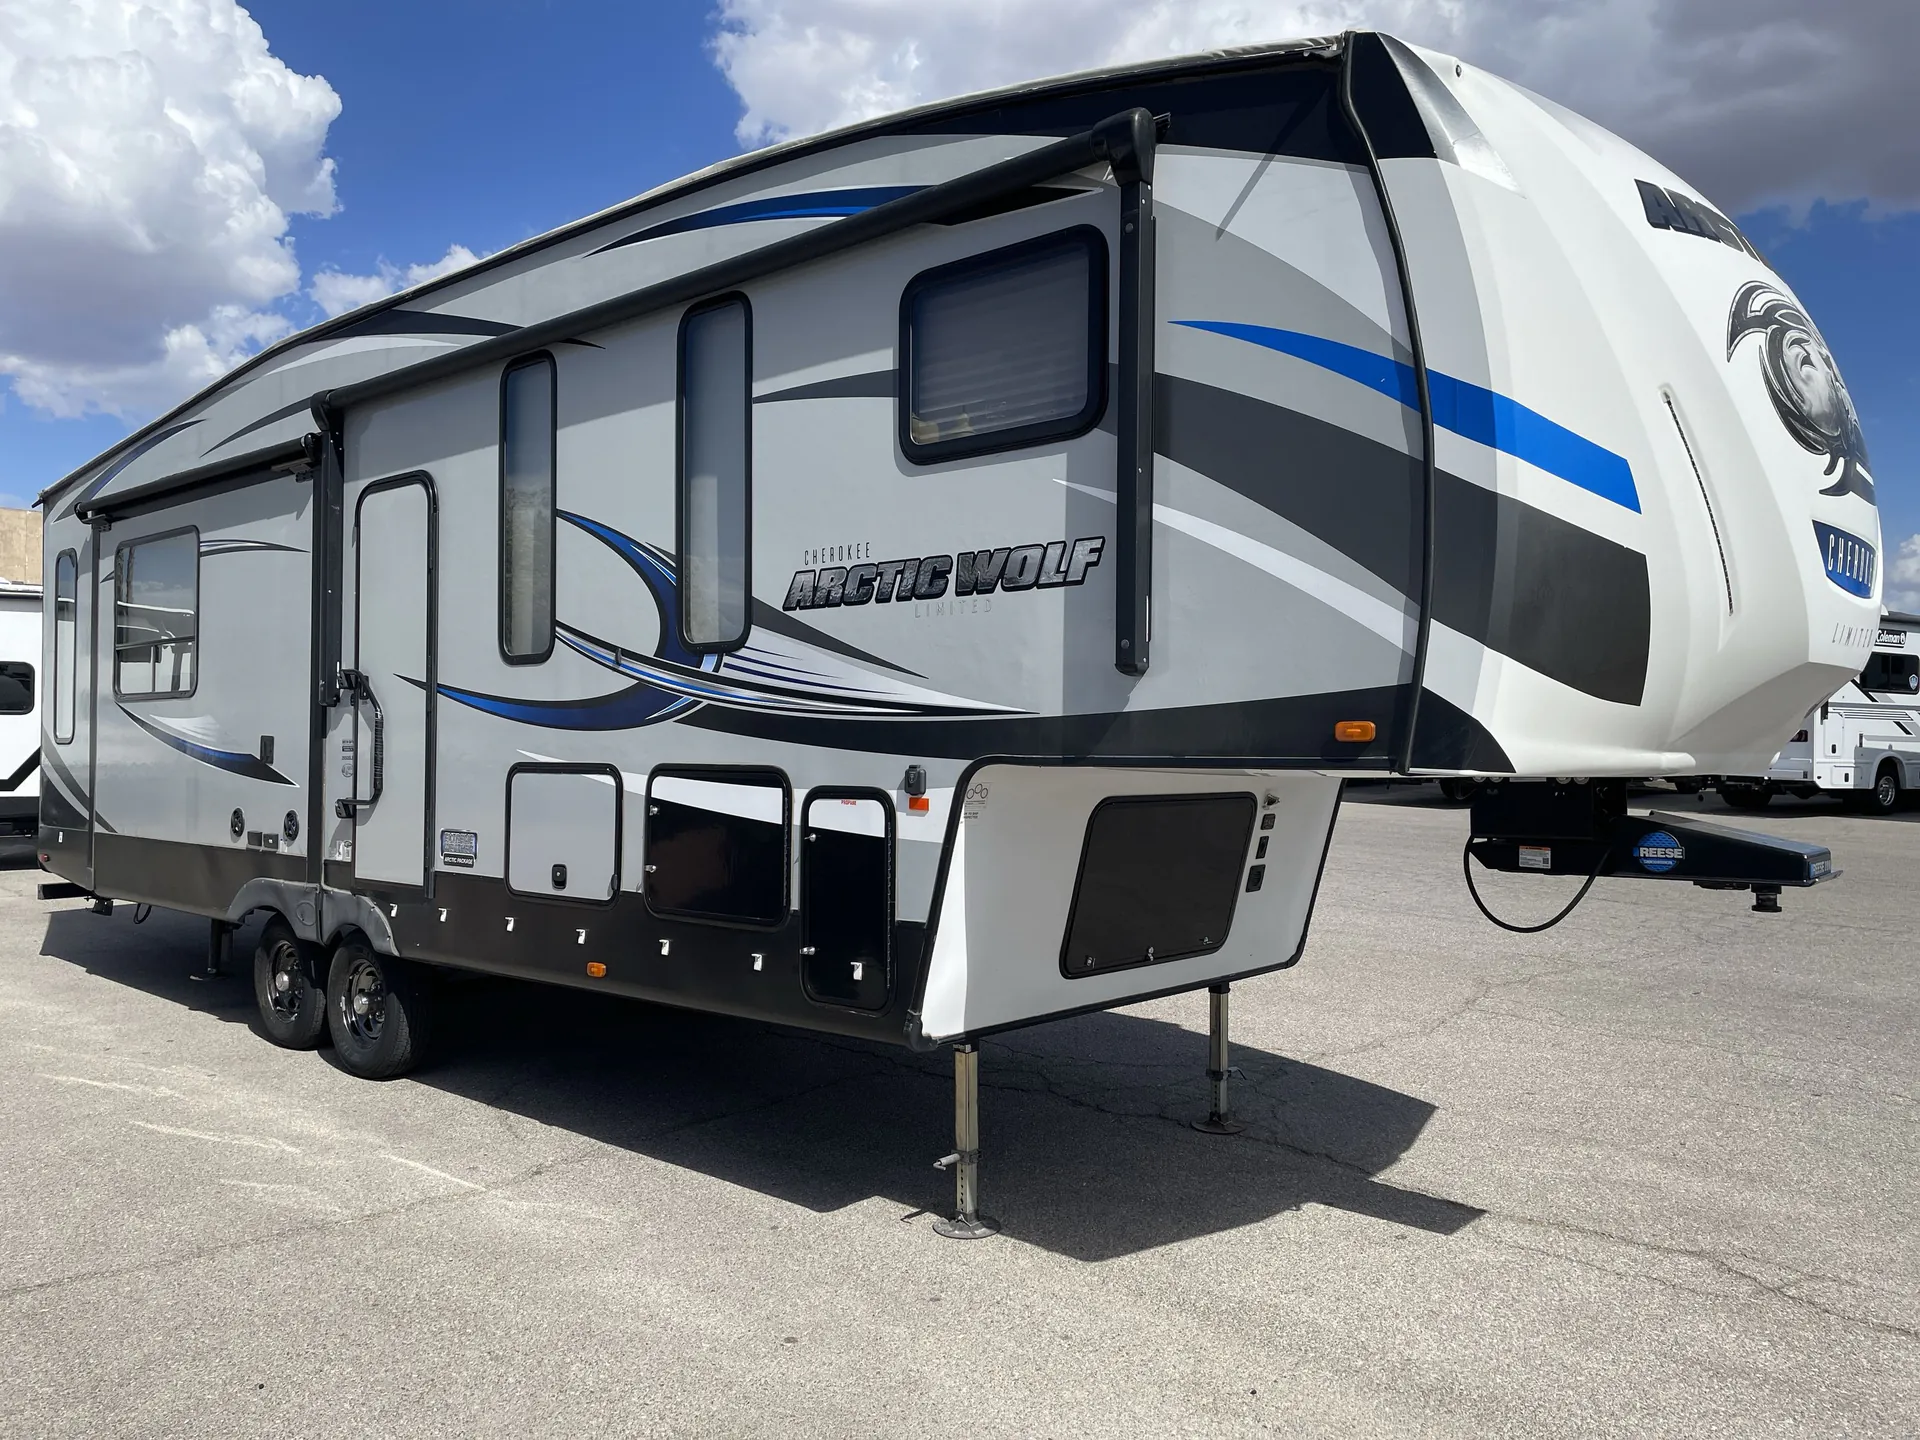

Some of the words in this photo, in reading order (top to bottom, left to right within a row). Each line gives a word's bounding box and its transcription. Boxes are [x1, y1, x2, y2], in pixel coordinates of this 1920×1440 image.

[804, 541, 871, 566] CHEROKEE
[782, 554, 954, 611] ARCTIC
[954, 536, 1105, 597] WOLF
[914, 599, 992, 619] LIMITED
[1876, 630, 1901, 644] Coleman
[1639, 847, 1683, 859] REESE
